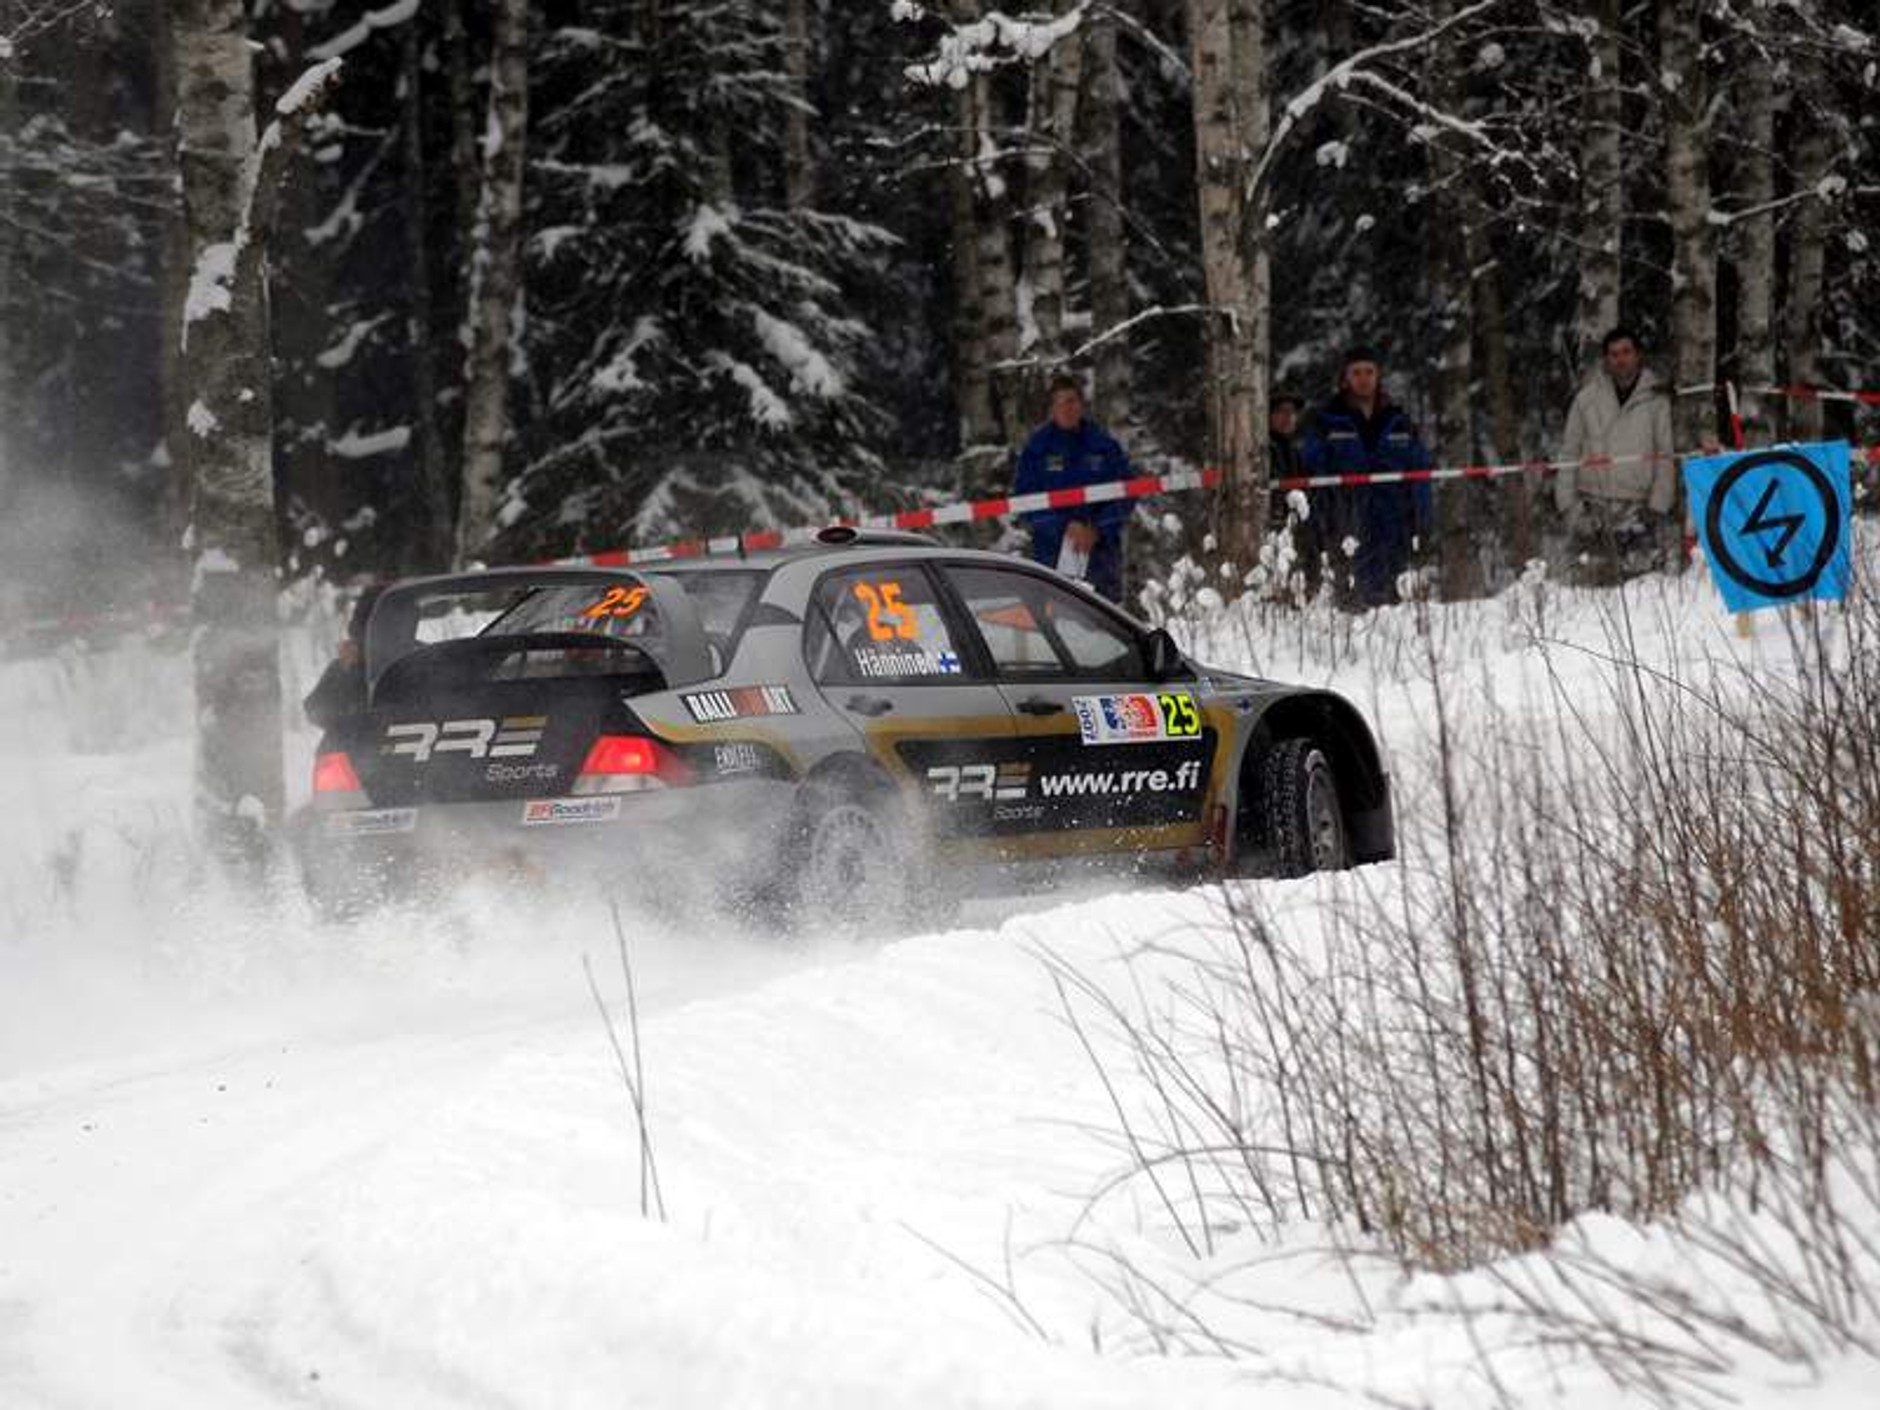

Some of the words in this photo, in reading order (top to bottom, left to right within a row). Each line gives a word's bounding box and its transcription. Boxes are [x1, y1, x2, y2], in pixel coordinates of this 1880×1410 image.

[582, 585, 650, 617] 25
[852, 580, 917, 641] 25
[1159, 692, 1200, 736] 25
[1041, 761, 1201, 797] www.rre.fi
